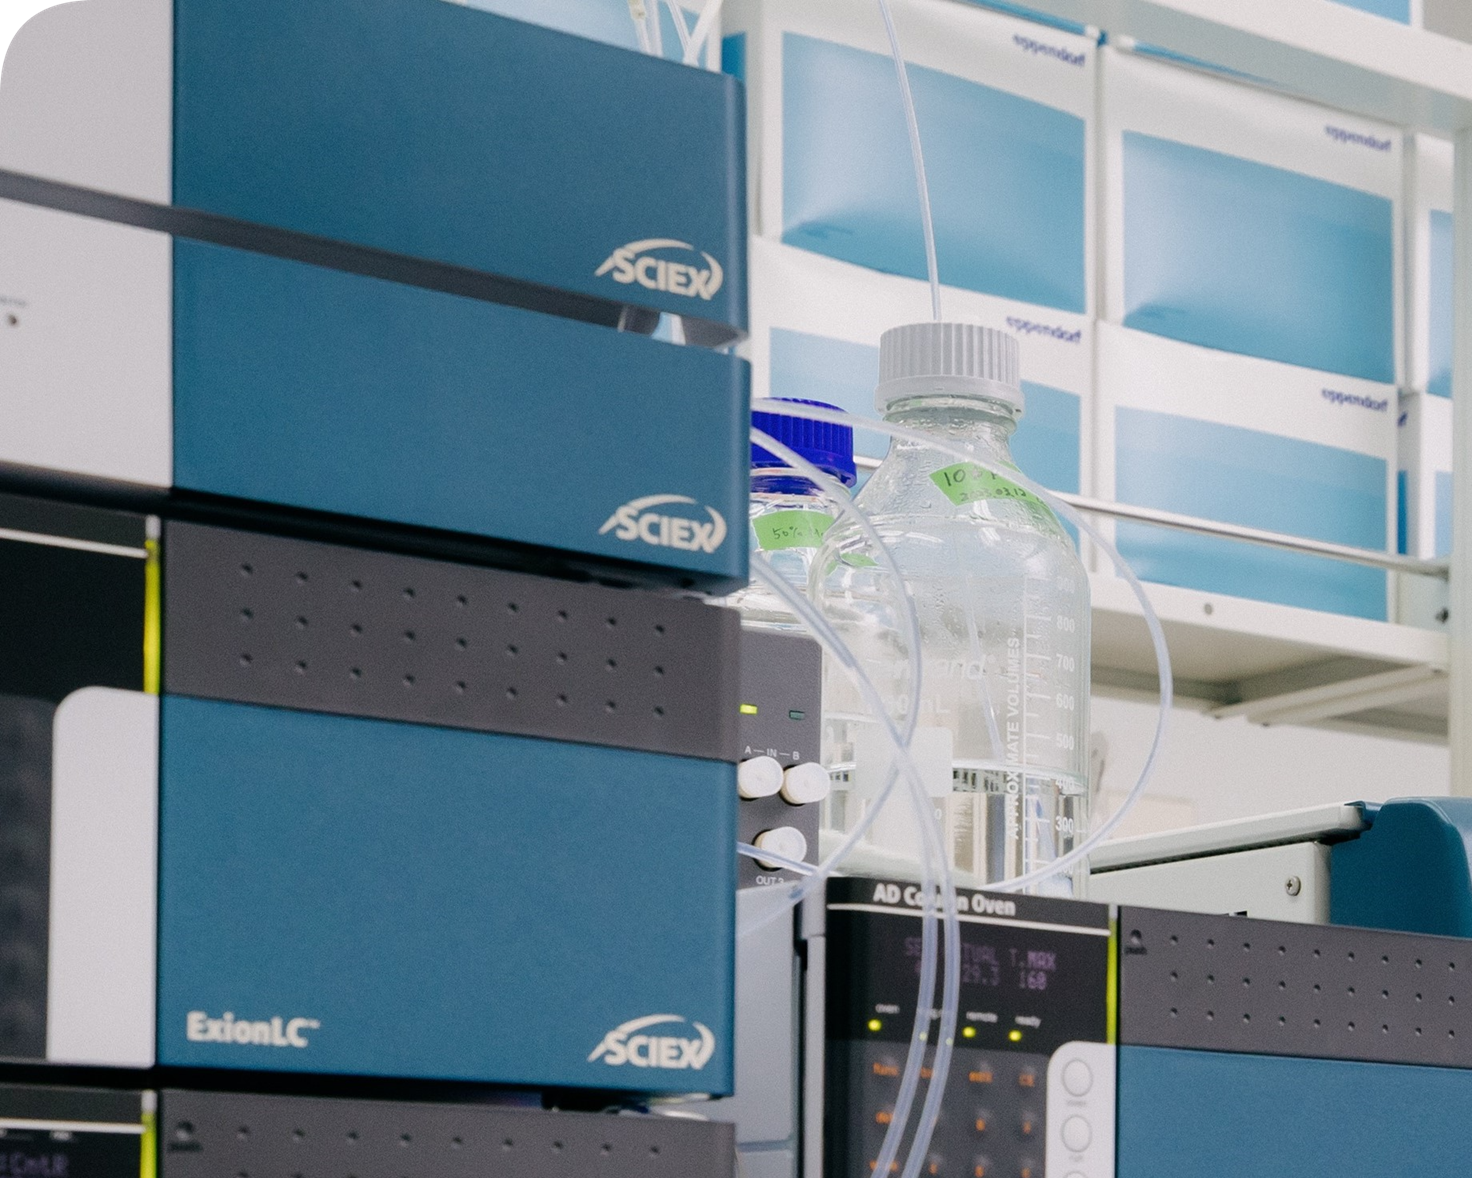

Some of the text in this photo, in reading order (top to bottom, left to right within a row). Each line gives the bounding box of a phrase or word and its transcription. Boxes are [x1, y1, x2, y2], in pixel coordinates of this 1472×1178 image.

[1012, 34, 1085, 67] eppendorf
[604, 243, 718, 300] SCIEX
[1006, 316, 1081, 344] eppendorf
[1322, 389, 1387, 412] eppendorf
[608, 499, 721, 553] SCIEX
[1056, 615, 1075, 633] 800
[1056, 654, 1075, 672] 700
[1007, 637, 1020, 719] VOLUMES
[1056, 693, 1075, 711] 600
[1056, 730, 1075, 750] 500
[744, 745, 752, 754] A
[792, 751, 800, 761] B
[1055, 816, 1074, 834] 300
[756, 875, 777, 885] OUT
[873, 883, 901, 904] AD
[972, 894, 1016, 916] Oven
[596, 1022, 711, 1070] SCIEX
